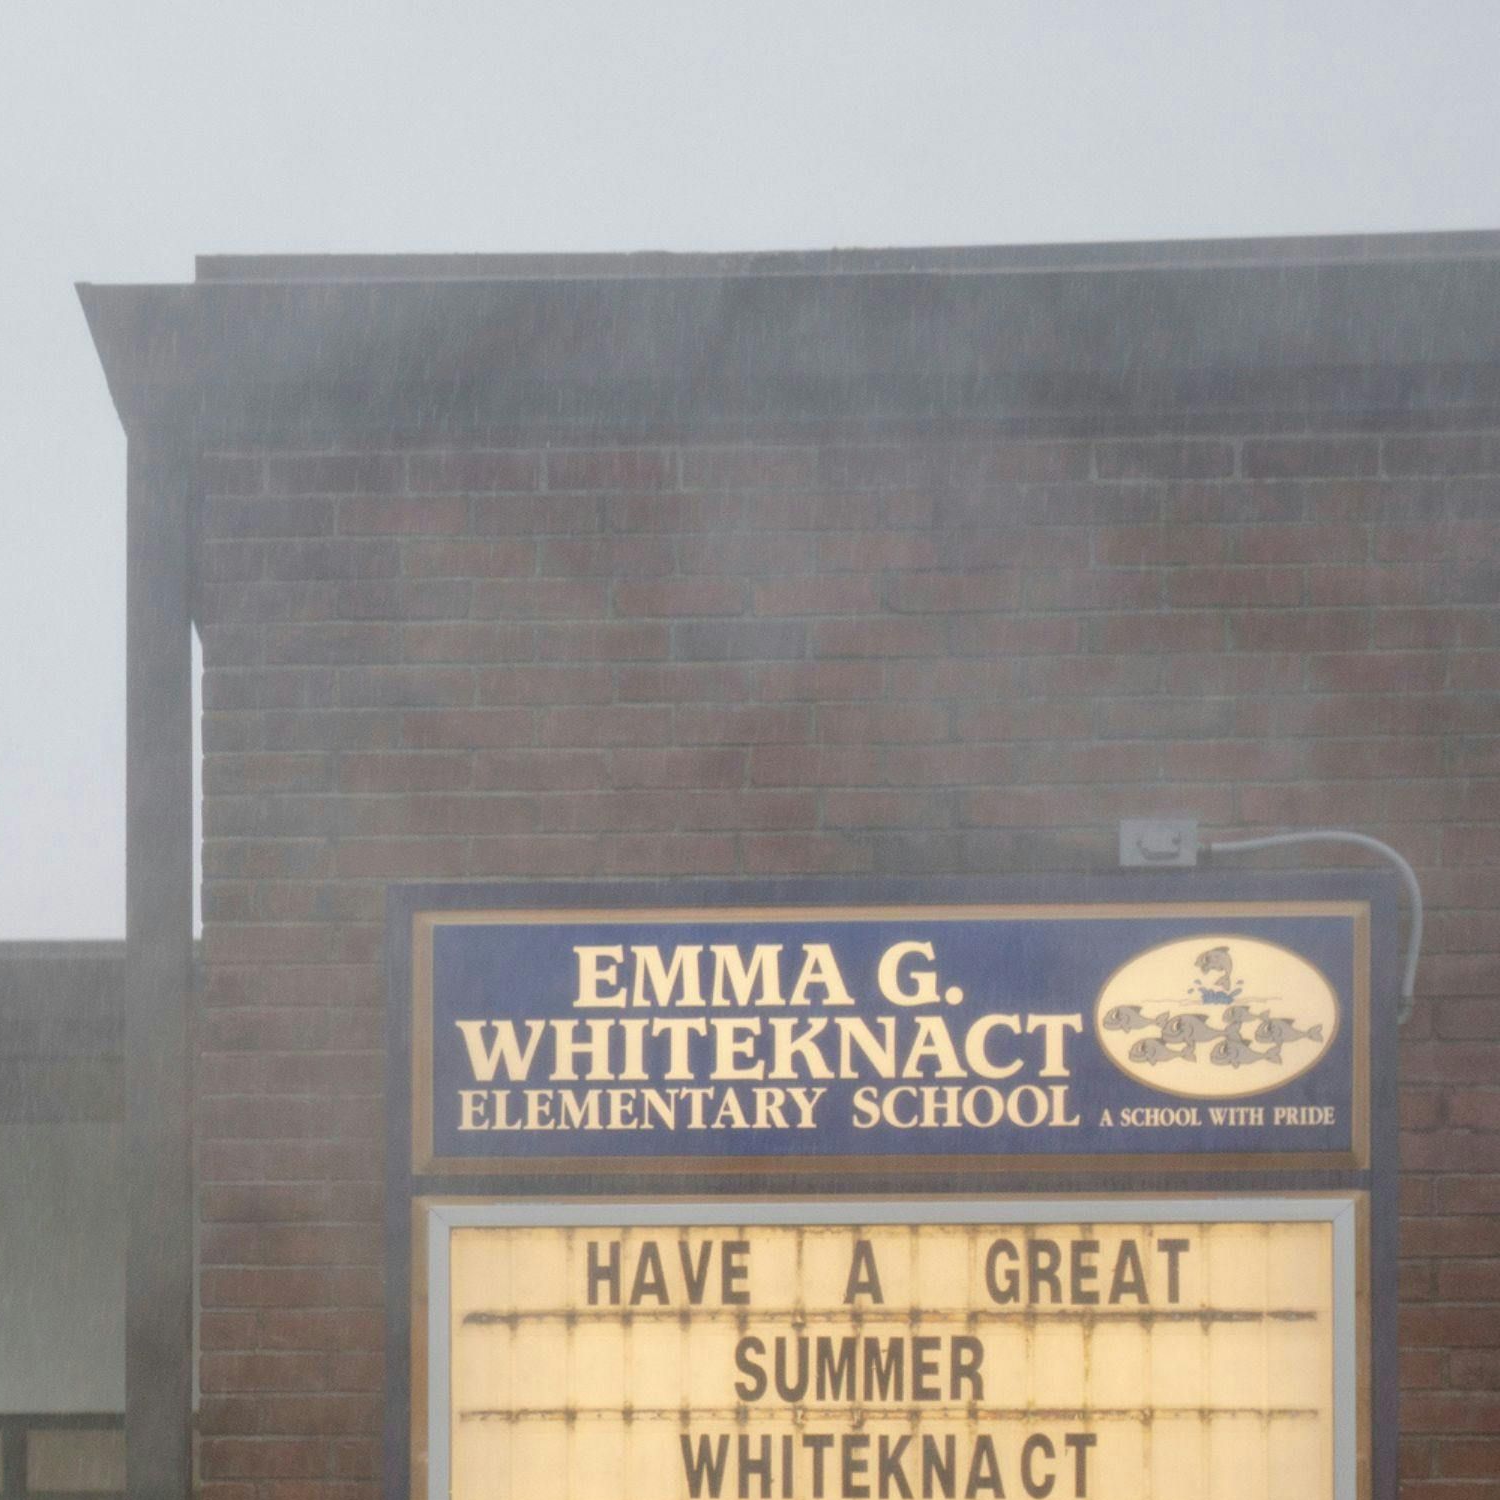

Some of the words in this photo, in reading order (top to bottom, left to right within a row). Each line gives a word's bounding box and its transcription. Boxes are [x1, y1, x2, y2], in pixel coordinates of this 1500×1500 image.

[573, 943, 856, 1008] EMMA
[878, 941, 964, 1007] G.
[455, 1013, 1083, 1082] WHITEKNACT
[458, 1087, 827, 1132] ELEMENTARY
[852, 1085, 1081, 1130] SCHOOL
[1099, 1108, 1114, 1127] A
[1119, 1107, 1203, 1127] SCHOOL
[1209, 1107, 1264, 1127] WITH
[1272, 1106, 1336, 1127] PRIDE
[585, 1240, 751, 1306] HAVE
[843, 1240, 884, 1305] A
[984, 1238, 1191, 1305] GREAT
[733, 1336, 986, 1402] SUMMER
[681, 1433, 1097, 1500] WHITEKNACT
